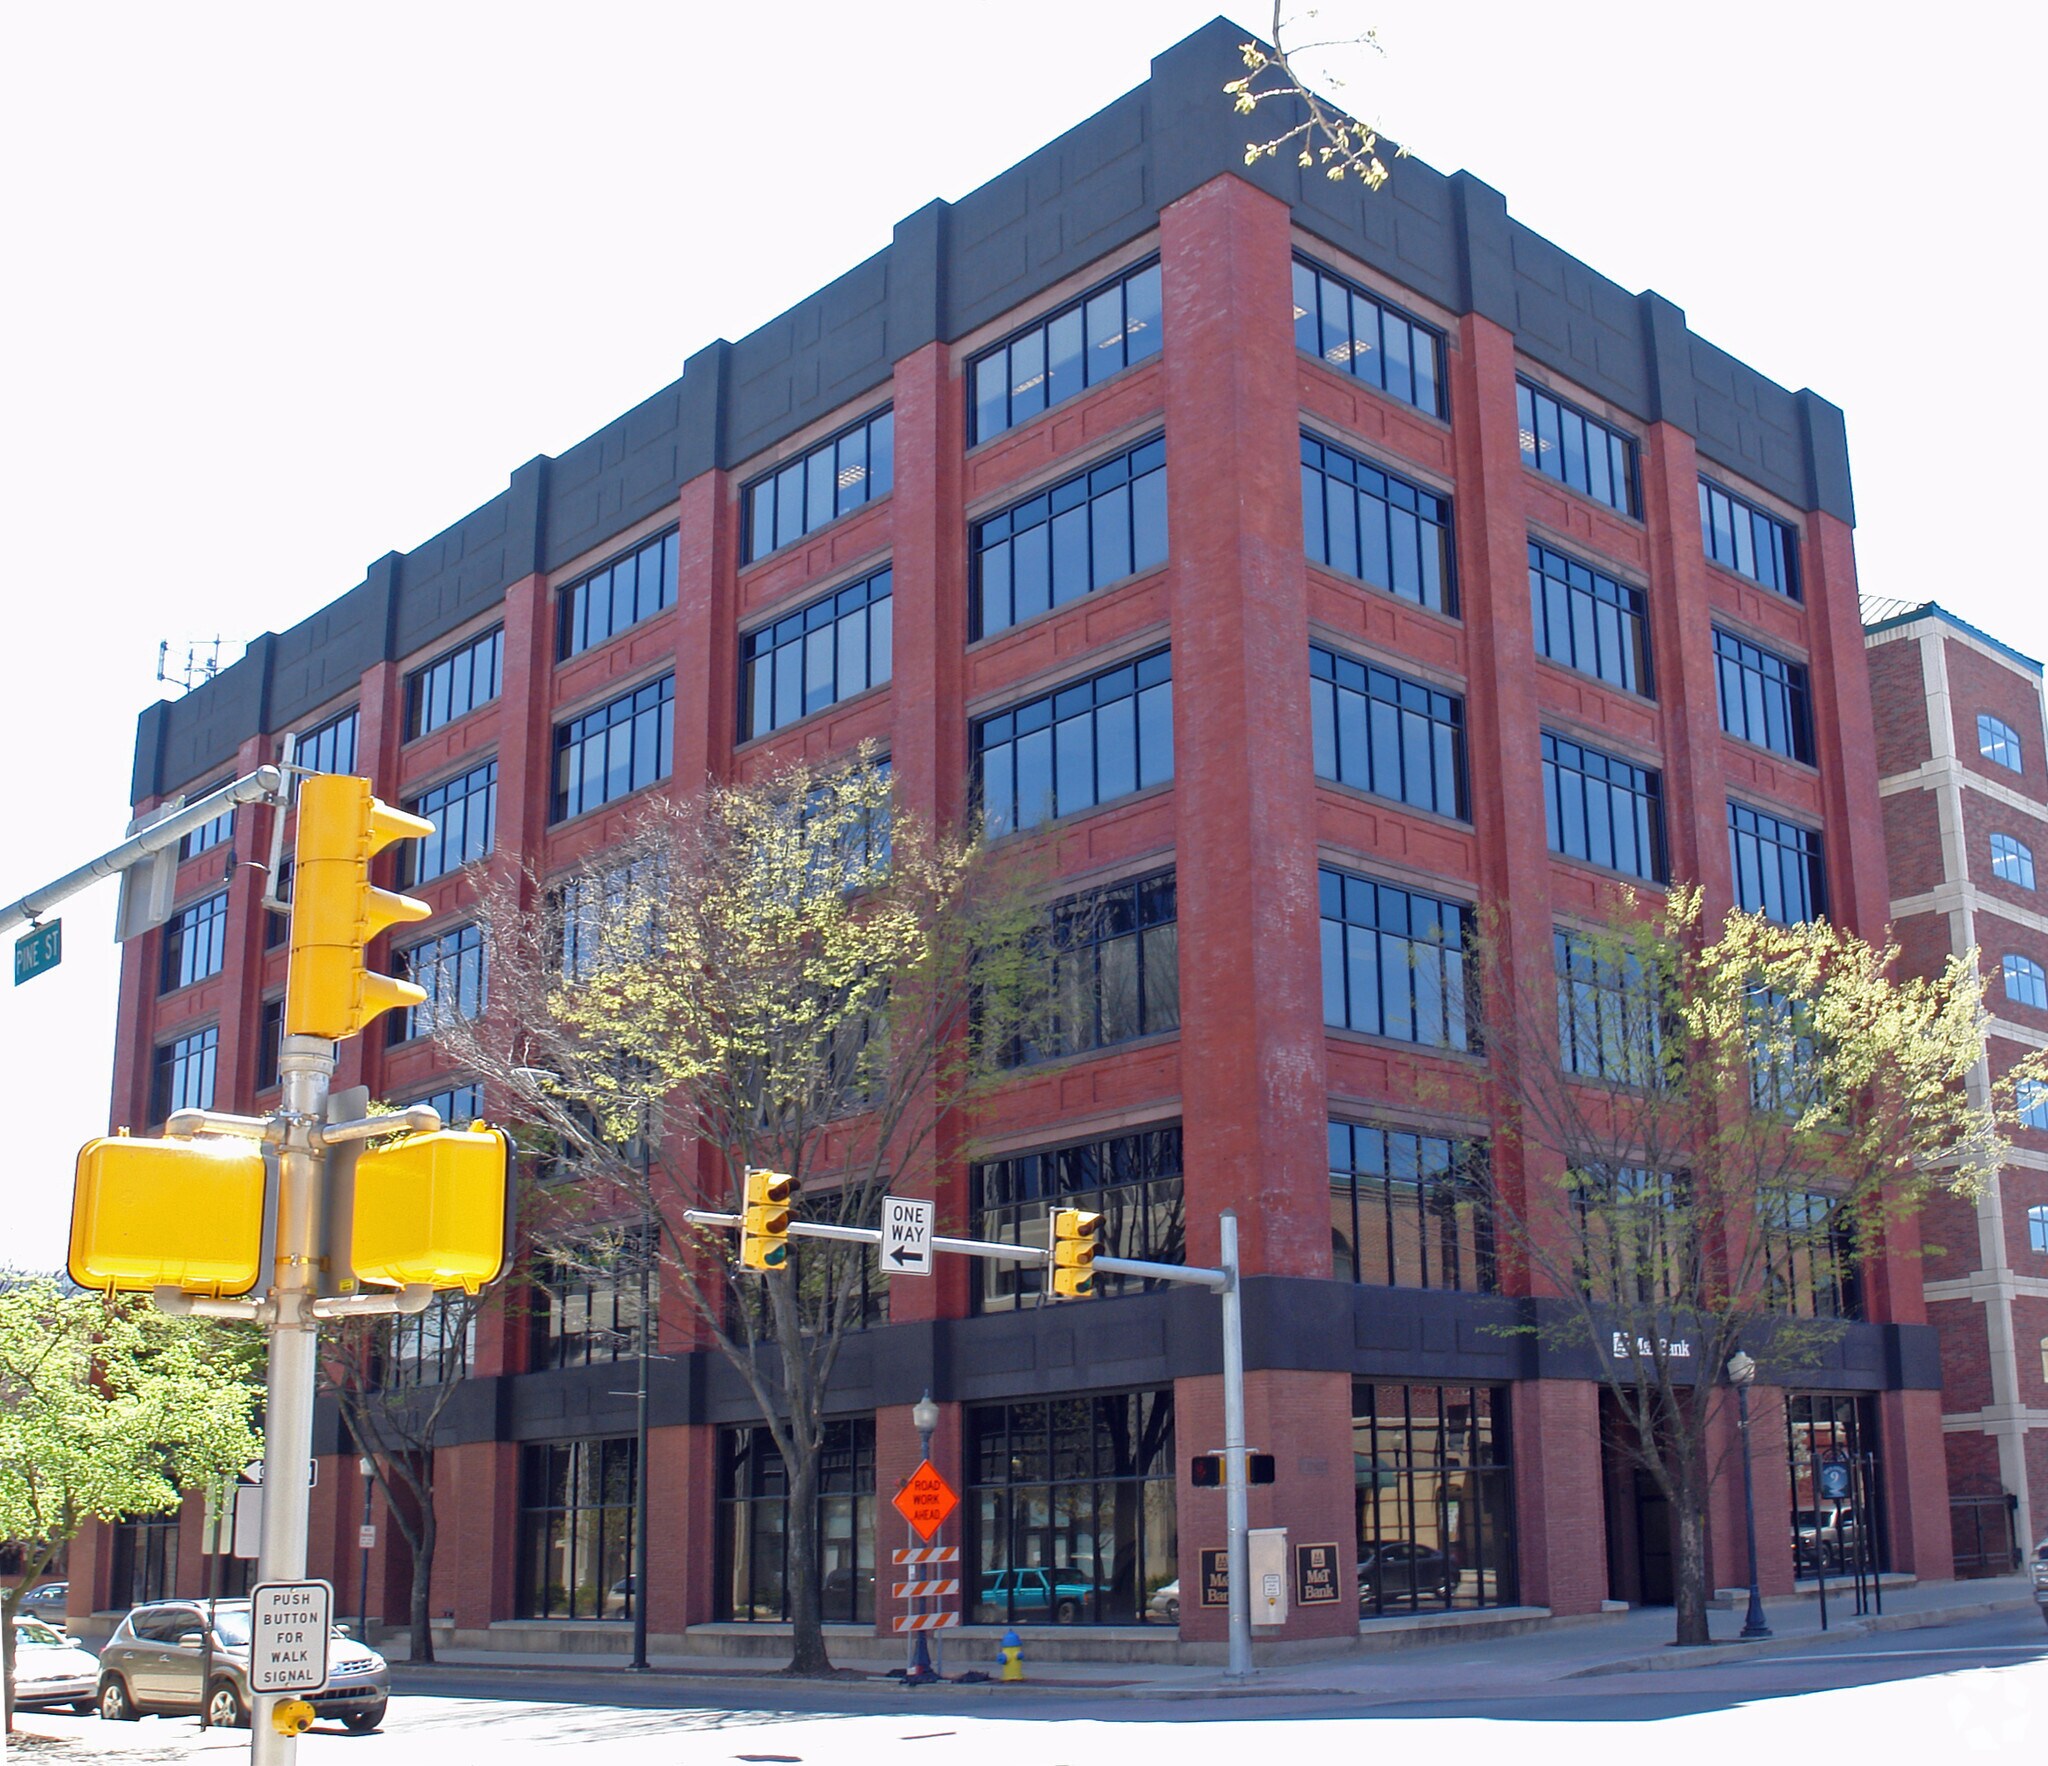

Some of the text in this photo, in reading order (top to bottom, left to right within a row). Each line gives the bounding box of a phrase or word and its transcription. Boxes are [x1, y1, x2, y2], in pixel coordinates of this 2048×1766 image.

[17, 930, 59, 976] PINE ST
[893, 1205, 924, 1224] ONE
[892, 1224, 925, 1243] WAY
[914, 1480, 941, 1491] ROAD
[913, 1494, 940, 1505] WORK
[914, 1509, 940, 1520] AHEAD
[1306, 1569, 1331, 1584] M&T
[1207, 1588, 1229, 1602] Ban
[1304, 1584, 1334, 1600] Bank
[273, 1593, 311, 1606] PUSH
[264, 1612, 318, 1626] BUTTON
[277, 1631, 304, 1644] FOR
[271, 1650, 308, 1663] WALK
[264, 1669, 314, 1683] SIGNAL
